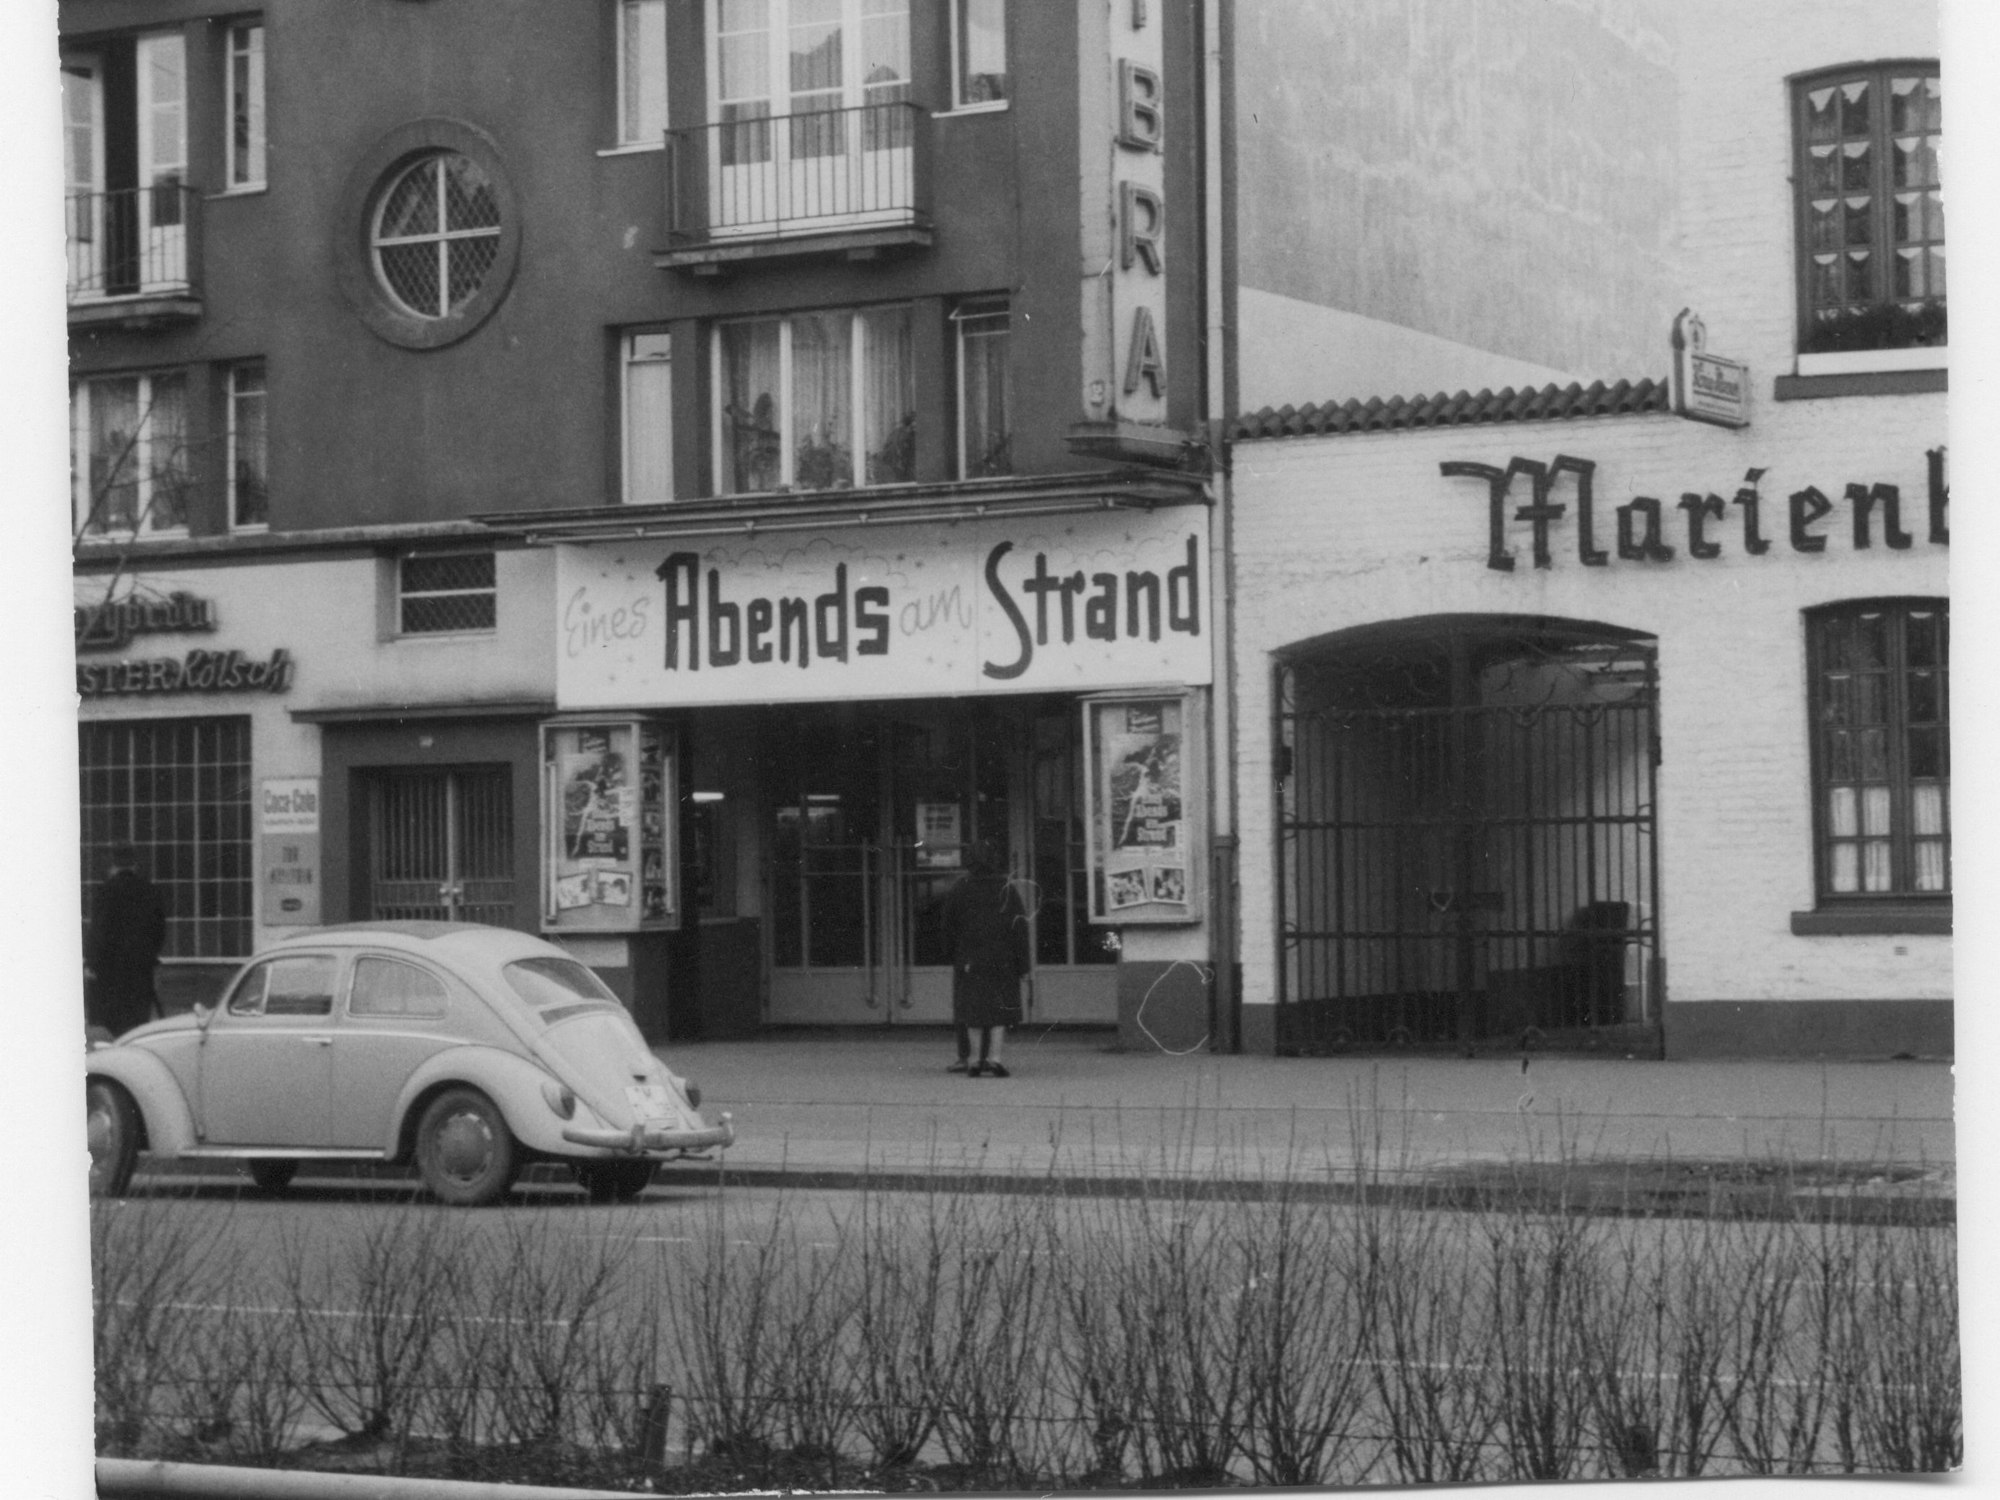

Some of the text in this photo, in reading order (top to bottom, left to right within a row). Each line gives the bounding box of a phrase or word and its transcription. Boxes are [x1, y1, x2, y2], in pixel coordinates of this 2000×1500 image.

[564, 533, 1200, 680] Eines Abends am Strand
